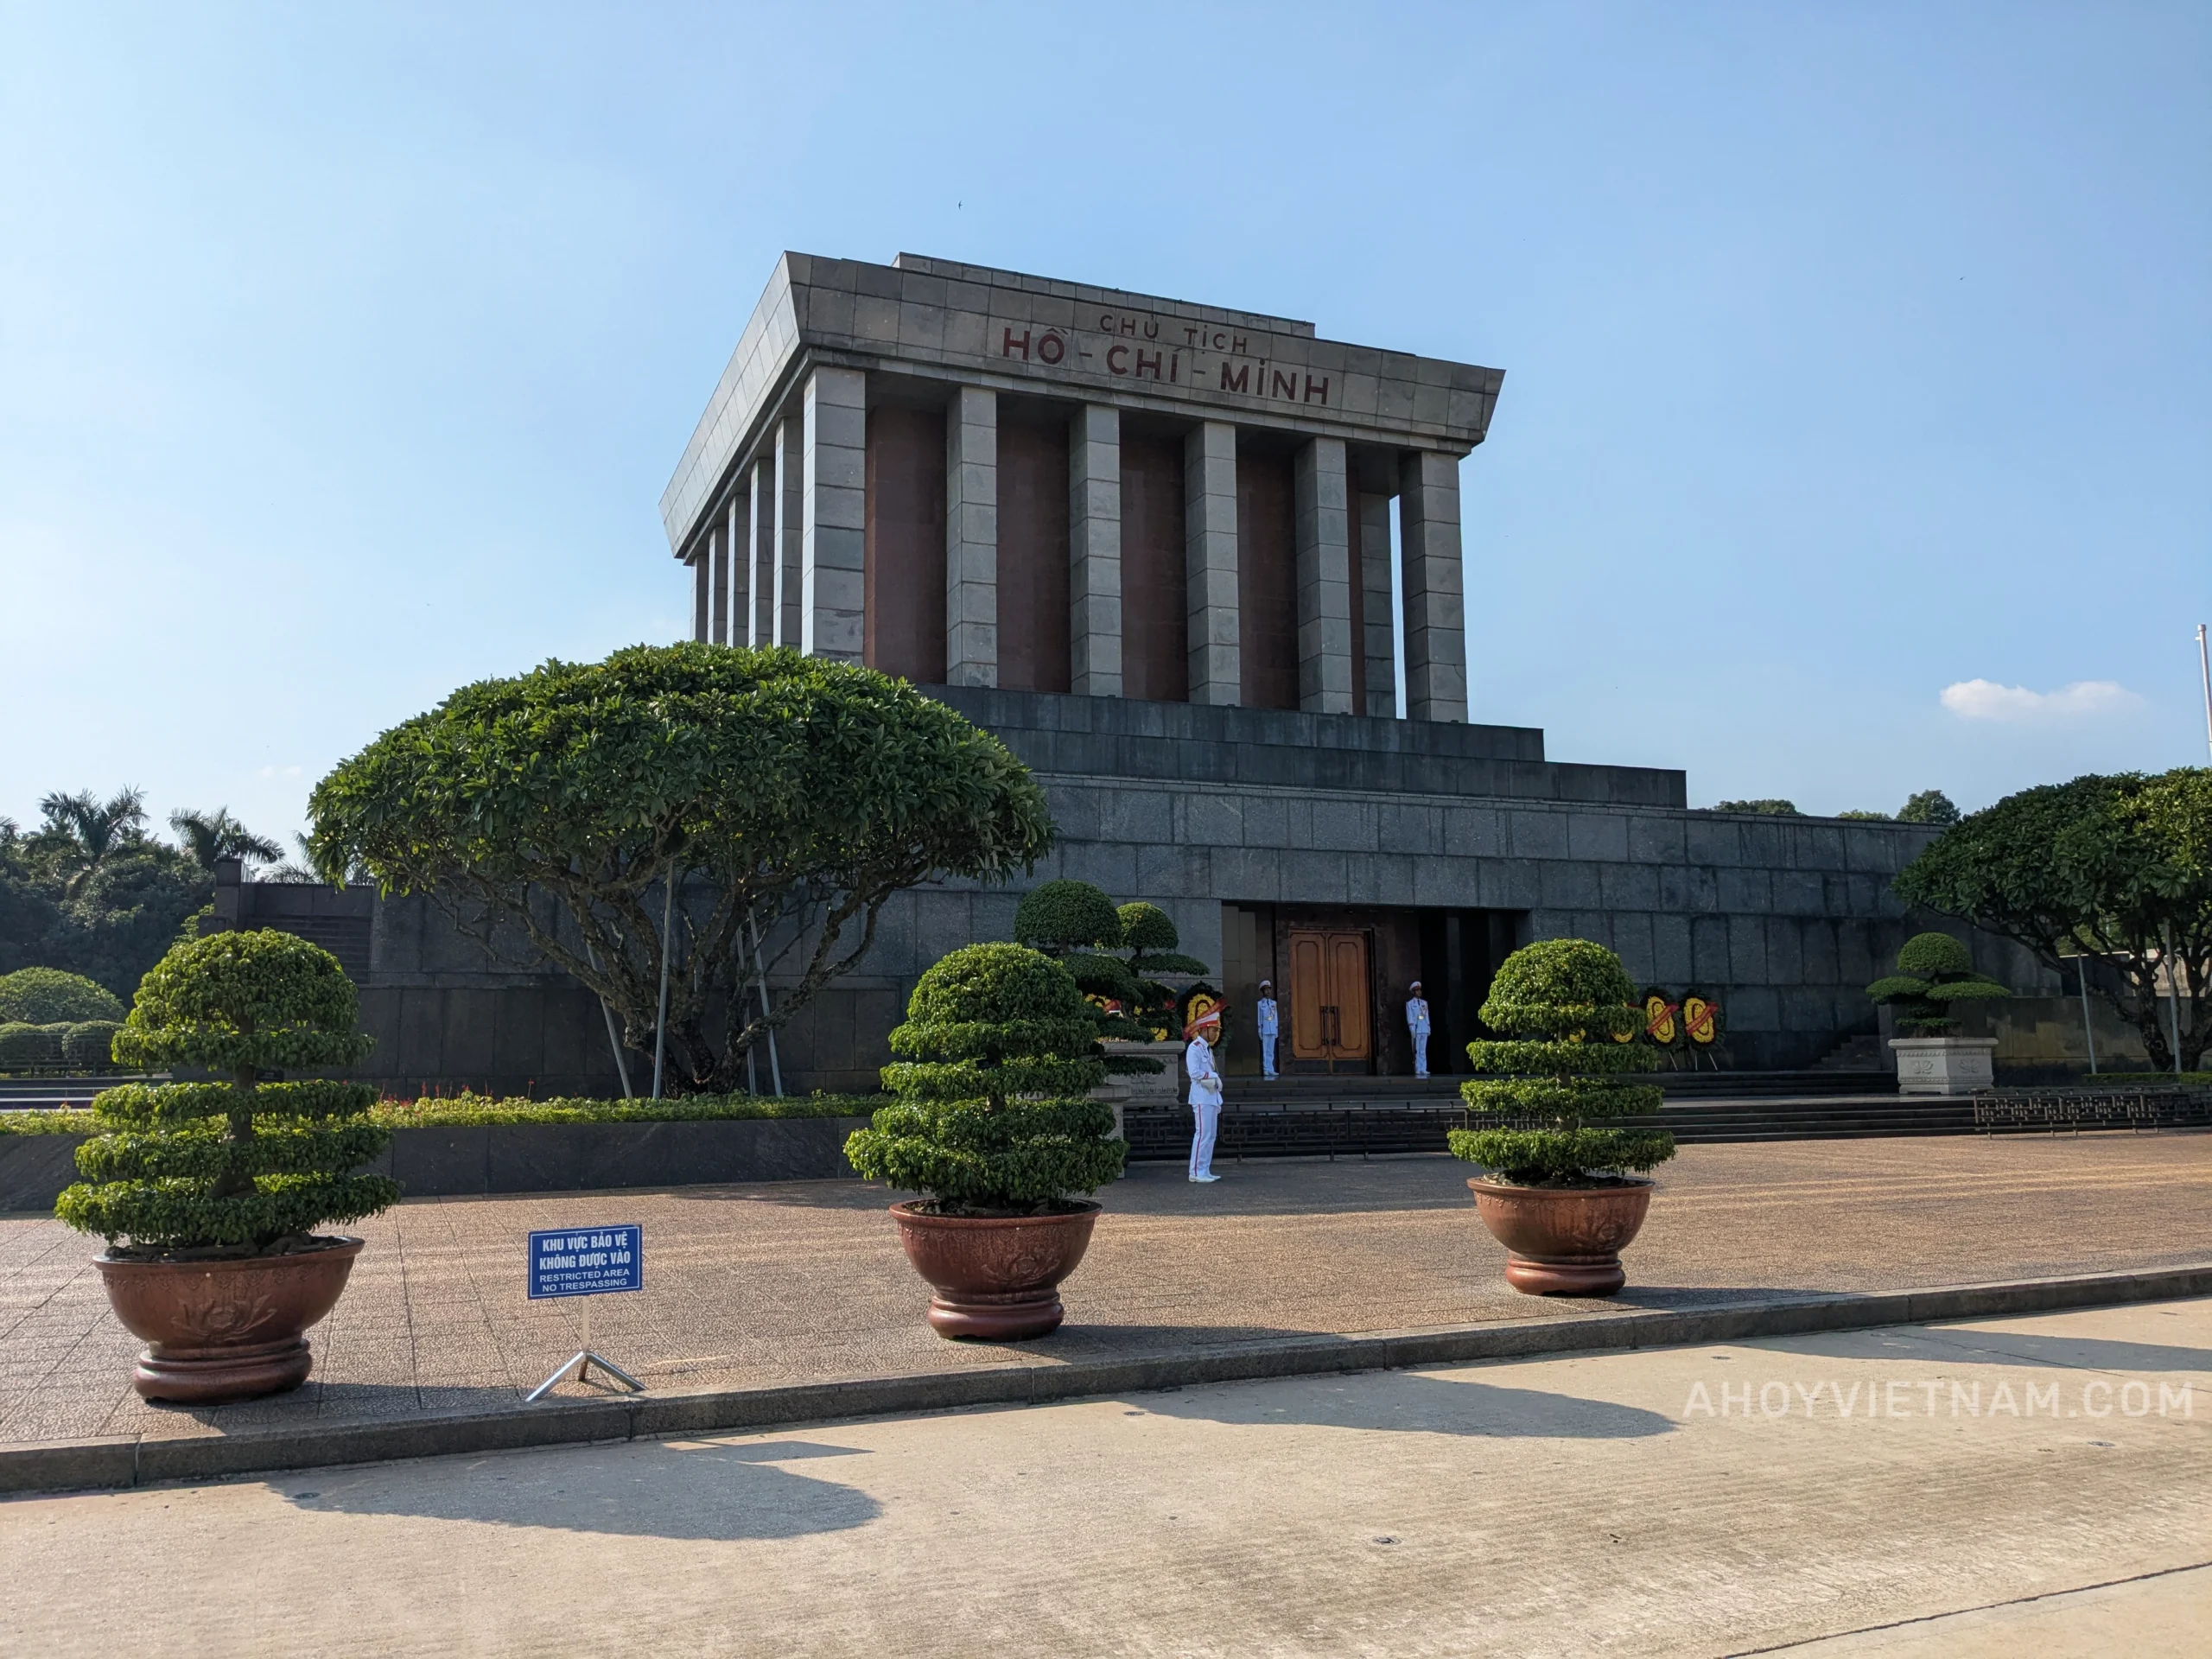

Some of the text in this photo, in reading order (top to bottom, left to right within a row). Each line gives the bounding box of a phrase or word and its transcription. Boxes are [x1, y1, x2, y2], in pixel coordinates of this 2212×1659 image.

[1003, 327, 1068, 365] HỒ
[1106, 345, 1182, 383] CHÍ
[543, 1231, 628, 1252] KHU VỰC BẢO VỆ
[539, 1249, 631, 1270] KHÔNG ĐƯỢC VÀO
[539, 1268, 630, 1283] RESTRICTED AREA
[542, 1278, 627, 1293] NO TRESPASSING
